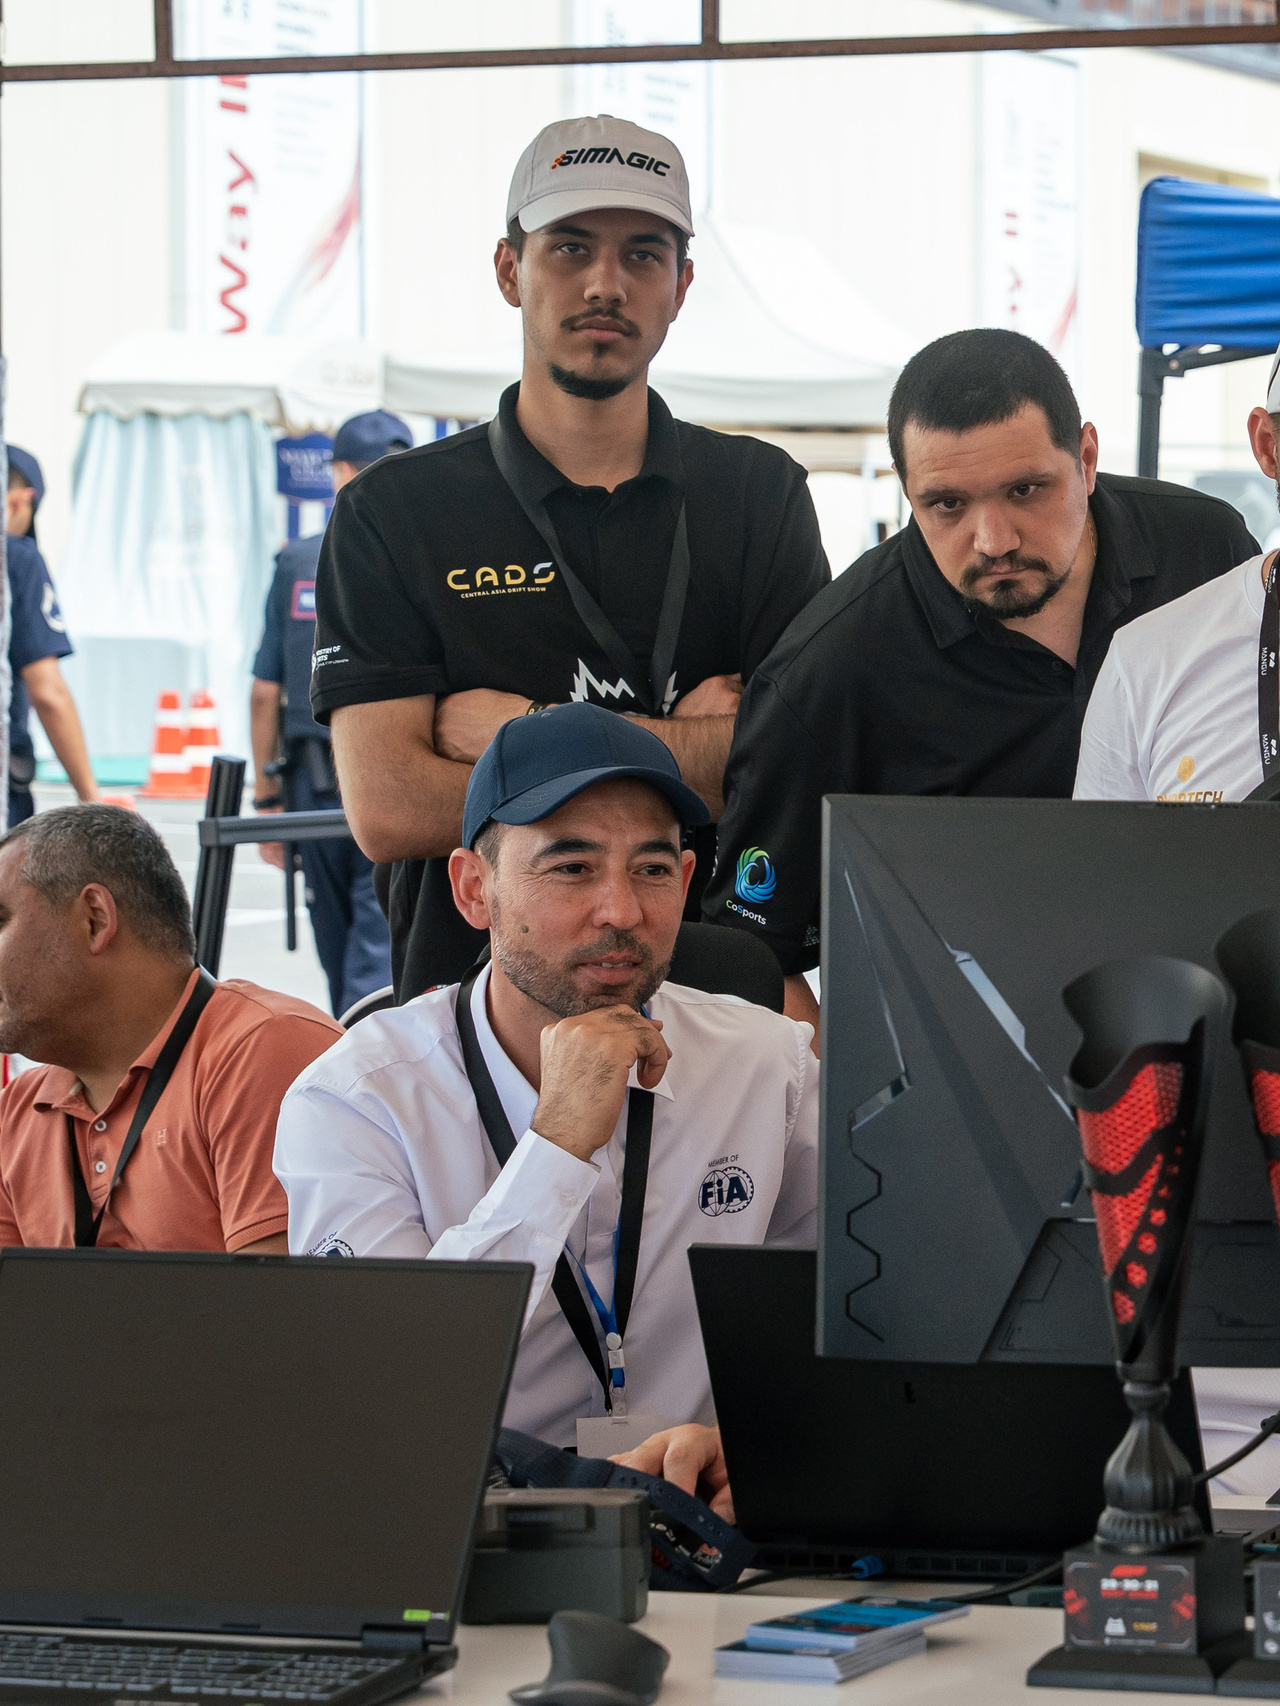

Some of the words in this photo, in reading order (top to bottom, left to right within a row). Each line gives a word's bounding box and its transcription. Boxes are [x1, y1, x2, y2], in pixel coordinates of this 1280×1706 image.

[557, 147, 671, 177] SIMAGIC
[446, 561, 556, 591] CADS
[460, 590, 490, 599] CENTRAL
[491, 588, 507, 596] ASIA
[1261, 733, 1271, 765] MANGU
[725, 899, 767, 926] CoSports
[708, 1156, 729, 1169] MEMBER
[730, 1153, 740, 1163] OF
